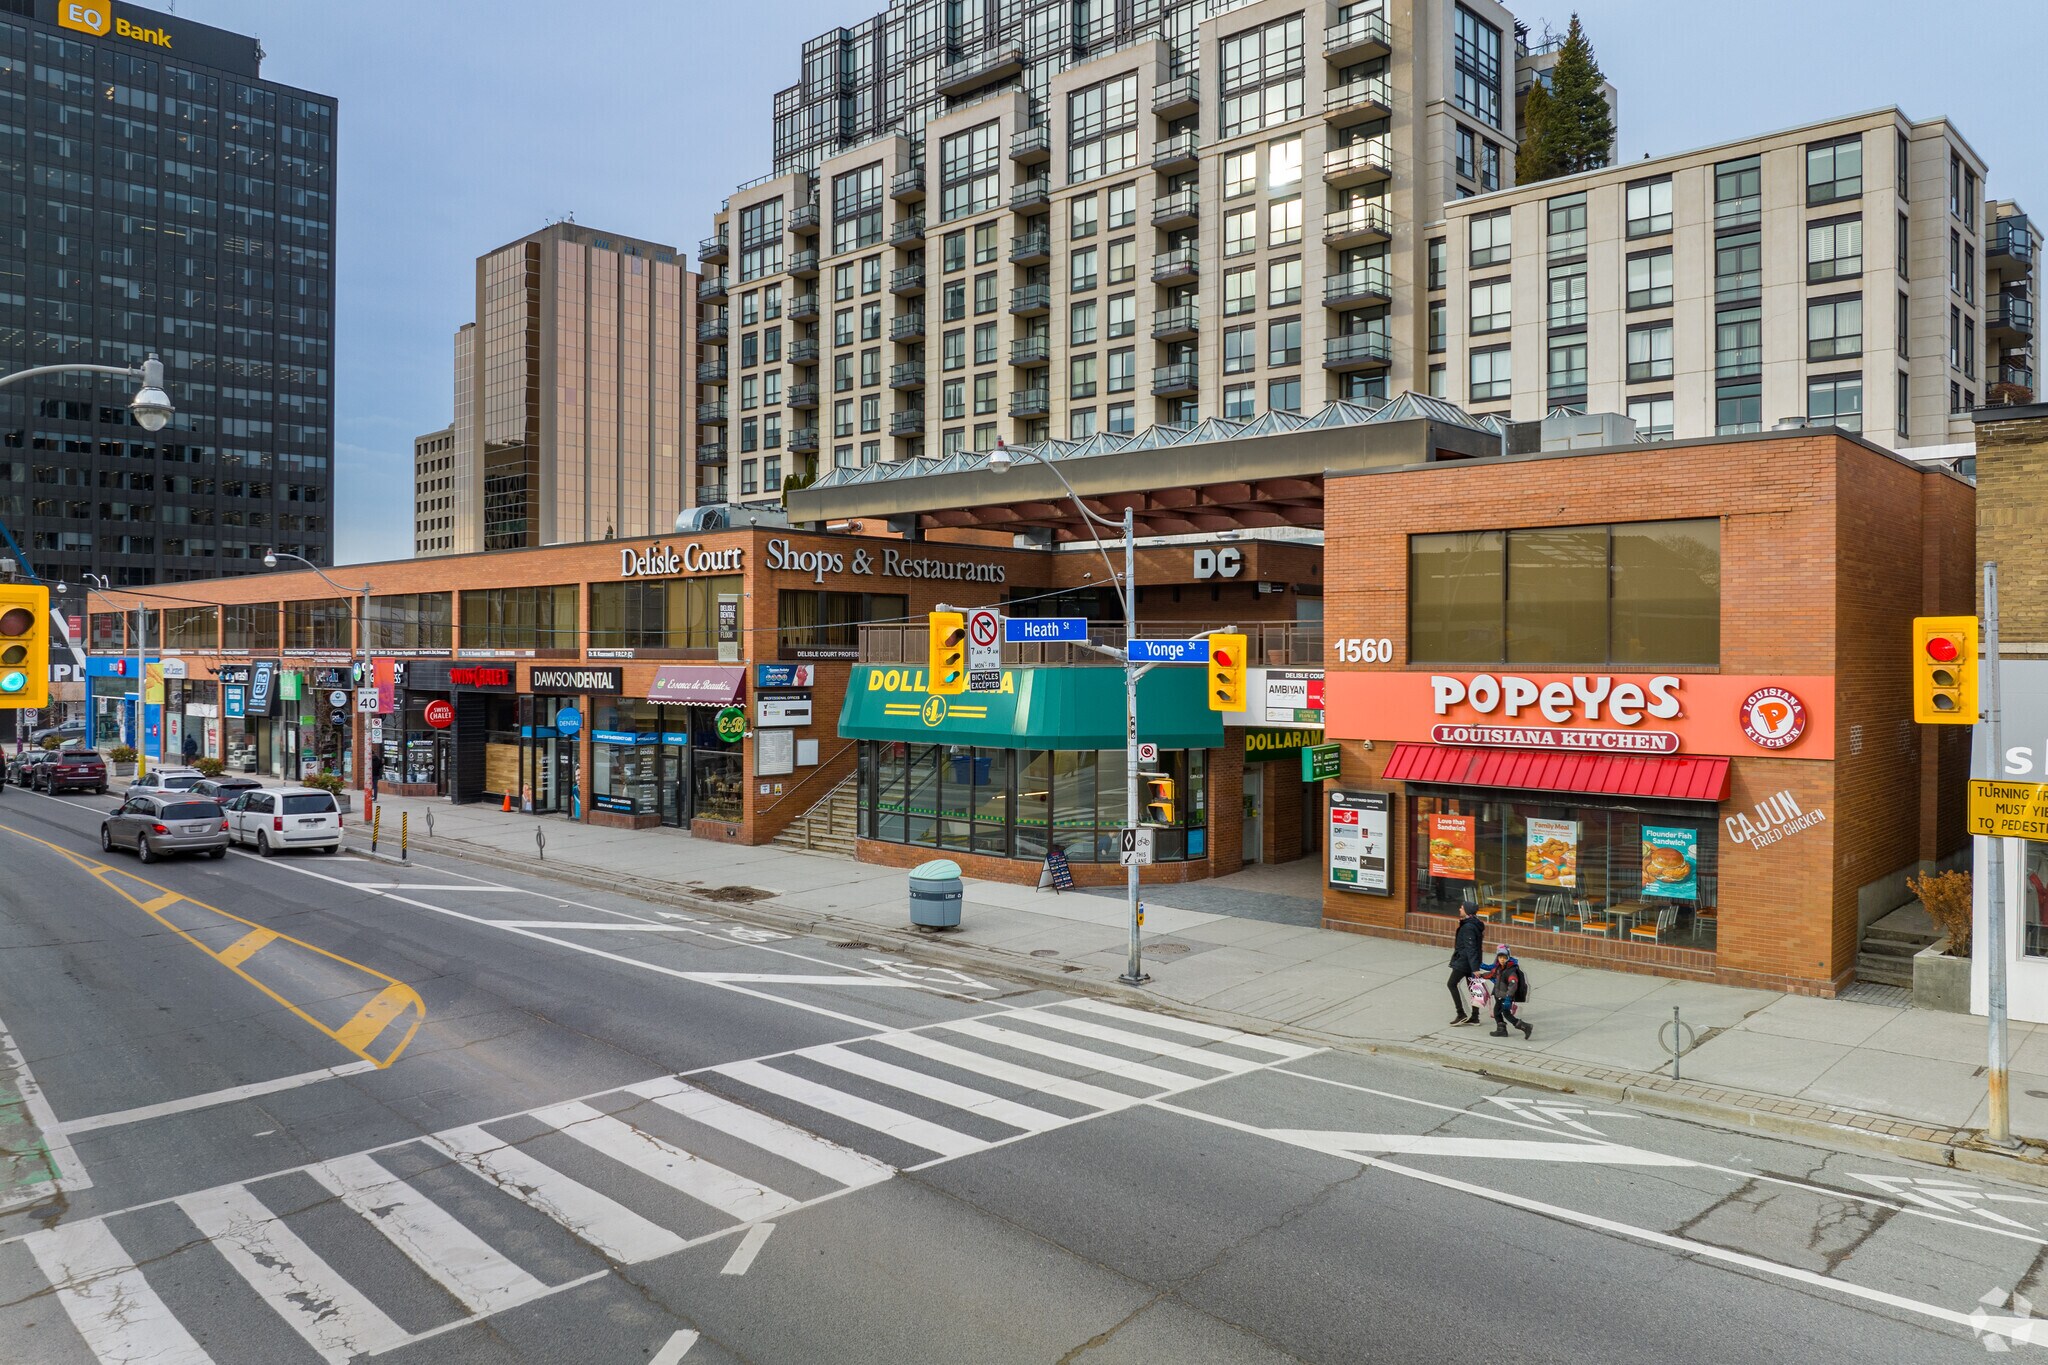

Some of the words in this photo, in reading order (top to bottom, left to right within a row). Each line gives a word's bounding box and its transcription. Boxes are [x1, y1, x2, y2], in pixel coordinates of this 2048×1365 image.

[69, 3, 102, 31] EQ
[116, 17, 172, 49] Bank
[621, 547, 680, 578] Delisle
[684, 543, 742, 573] Court
[766, 539, 844, 584] Shops
[852, 548, 874, 575] &
[882, 548, 1006, 582] Restaurants
[1194, 548, 1240, 578] DC
[1024, 622, 1059, 637] Heath
[1063, 622, 1070, 630] St
[1146, 642, 1184, 660] Yonge
[1188, 642, 1196, 650] St
[1334, 638, 1393, 662] 1560
[451, 668, 475, 684] SWISS
[474, 665, 509, 688] CHALET
[668, 678, 690, 689] Essence
[691, 680, 700, 689] de
[971, 673, 999, 681] BICYCLES
[971, 682, 1000, 690] EXCEPTED
[1269, 685, 1305, 694] AMBIYAN
[360, 698, 377, 708] 40
[1744, 688, 1802, 714] LOUISIANA
[1757, 702, 1788, 734] P
[1246, 729, 1325, 751] DOLLARAM
[1441, 727, 1556, 745] LOUISIANA
[1561, 732, 1668, 750] KITCHEN
[1745, 726, 1801, 747] KITCHEN
[1978, 787, 2030, 800] TURNING
[1726, 790, 1802, 844] CAJUN
[1996, 804, 2026, 815] MUST
[1534, 822, 1554, 831] Family
[1646, 830, 1677, 838] Flounder
[1751, 827, 1783, 850] FRIED
[1782, 809, 1826, 837] CHICKEN
[1978, 818, 1994, 828] TO
[2001, 820, 2048, 834] PEDEST
[1653, 838, 1685, 846] Sandwich
